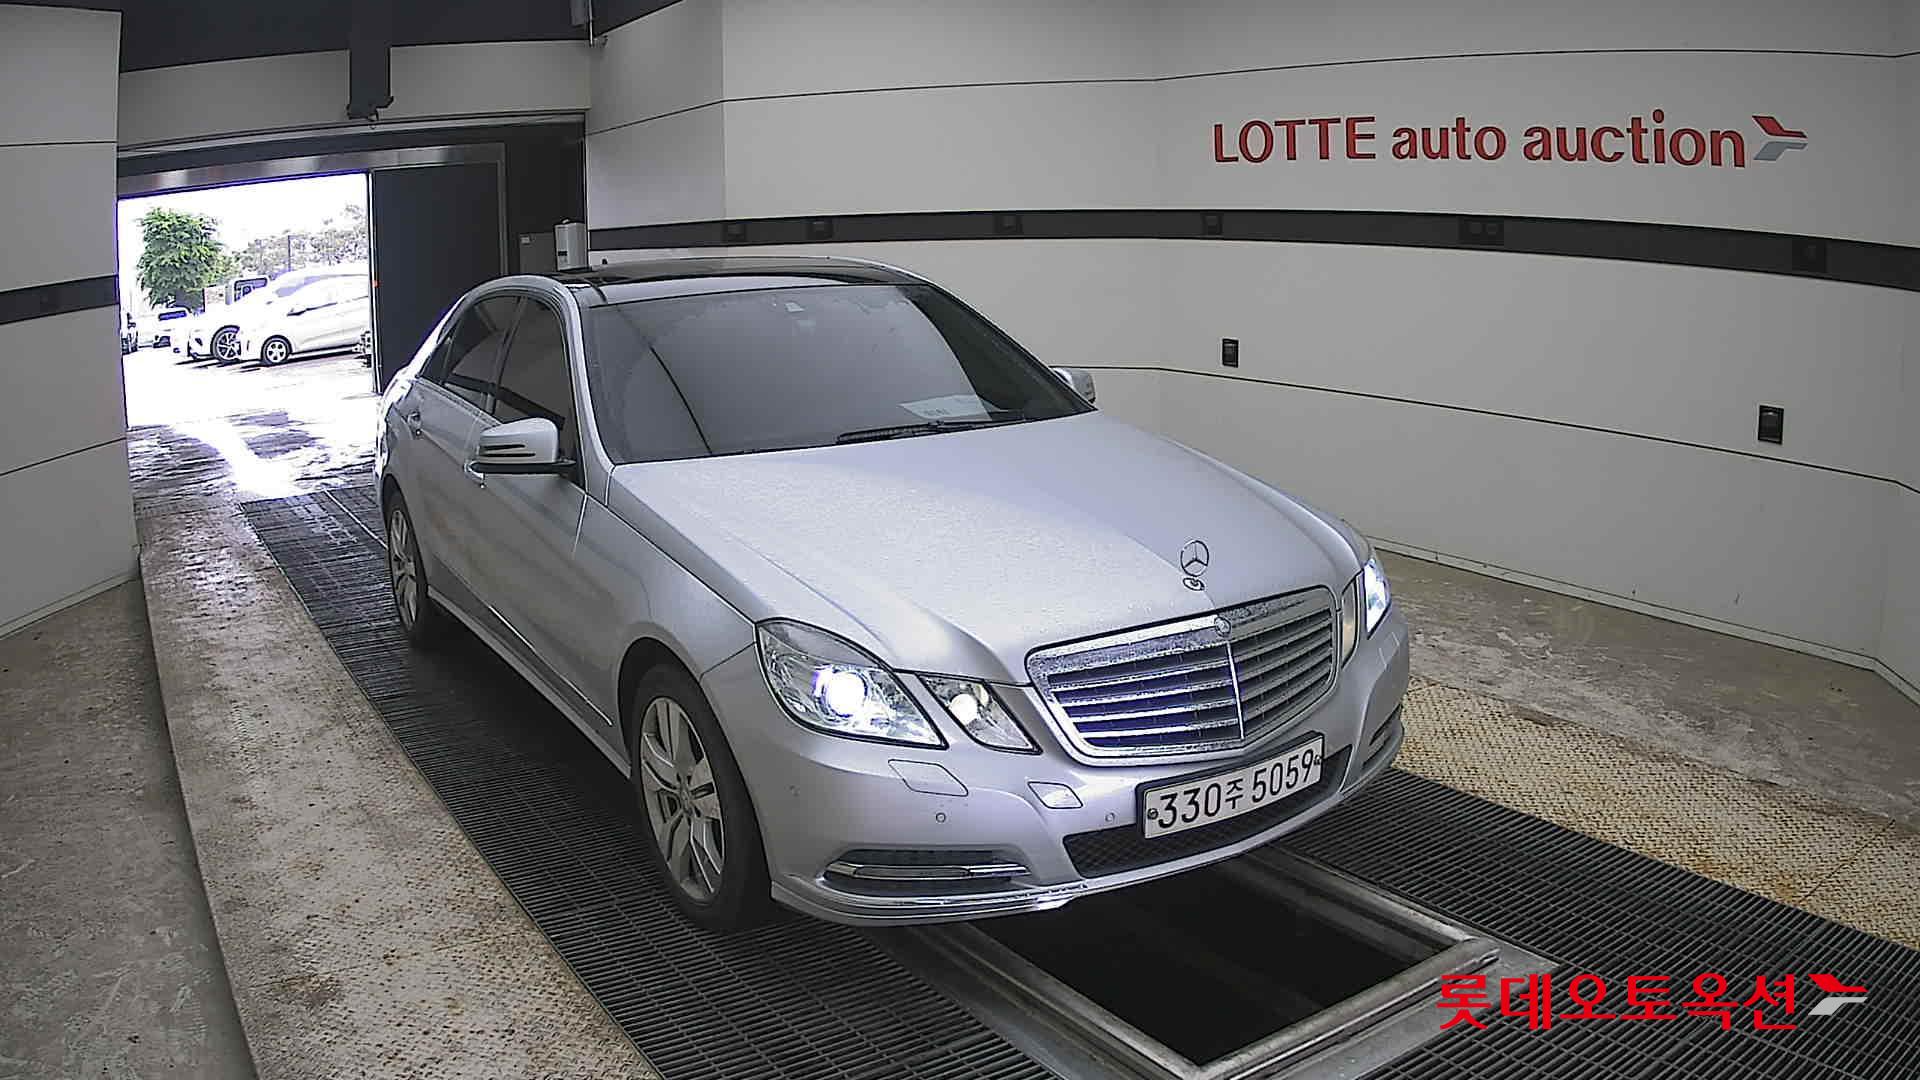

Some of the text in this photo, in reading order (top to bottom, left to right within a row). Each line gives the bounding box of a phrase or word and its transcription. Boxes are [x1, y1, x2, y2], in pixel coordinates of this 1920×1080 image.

[1213, 108, 1746, 168] LOTTE auto auction
[1158, 749, 1314, 829] 330주 5059
